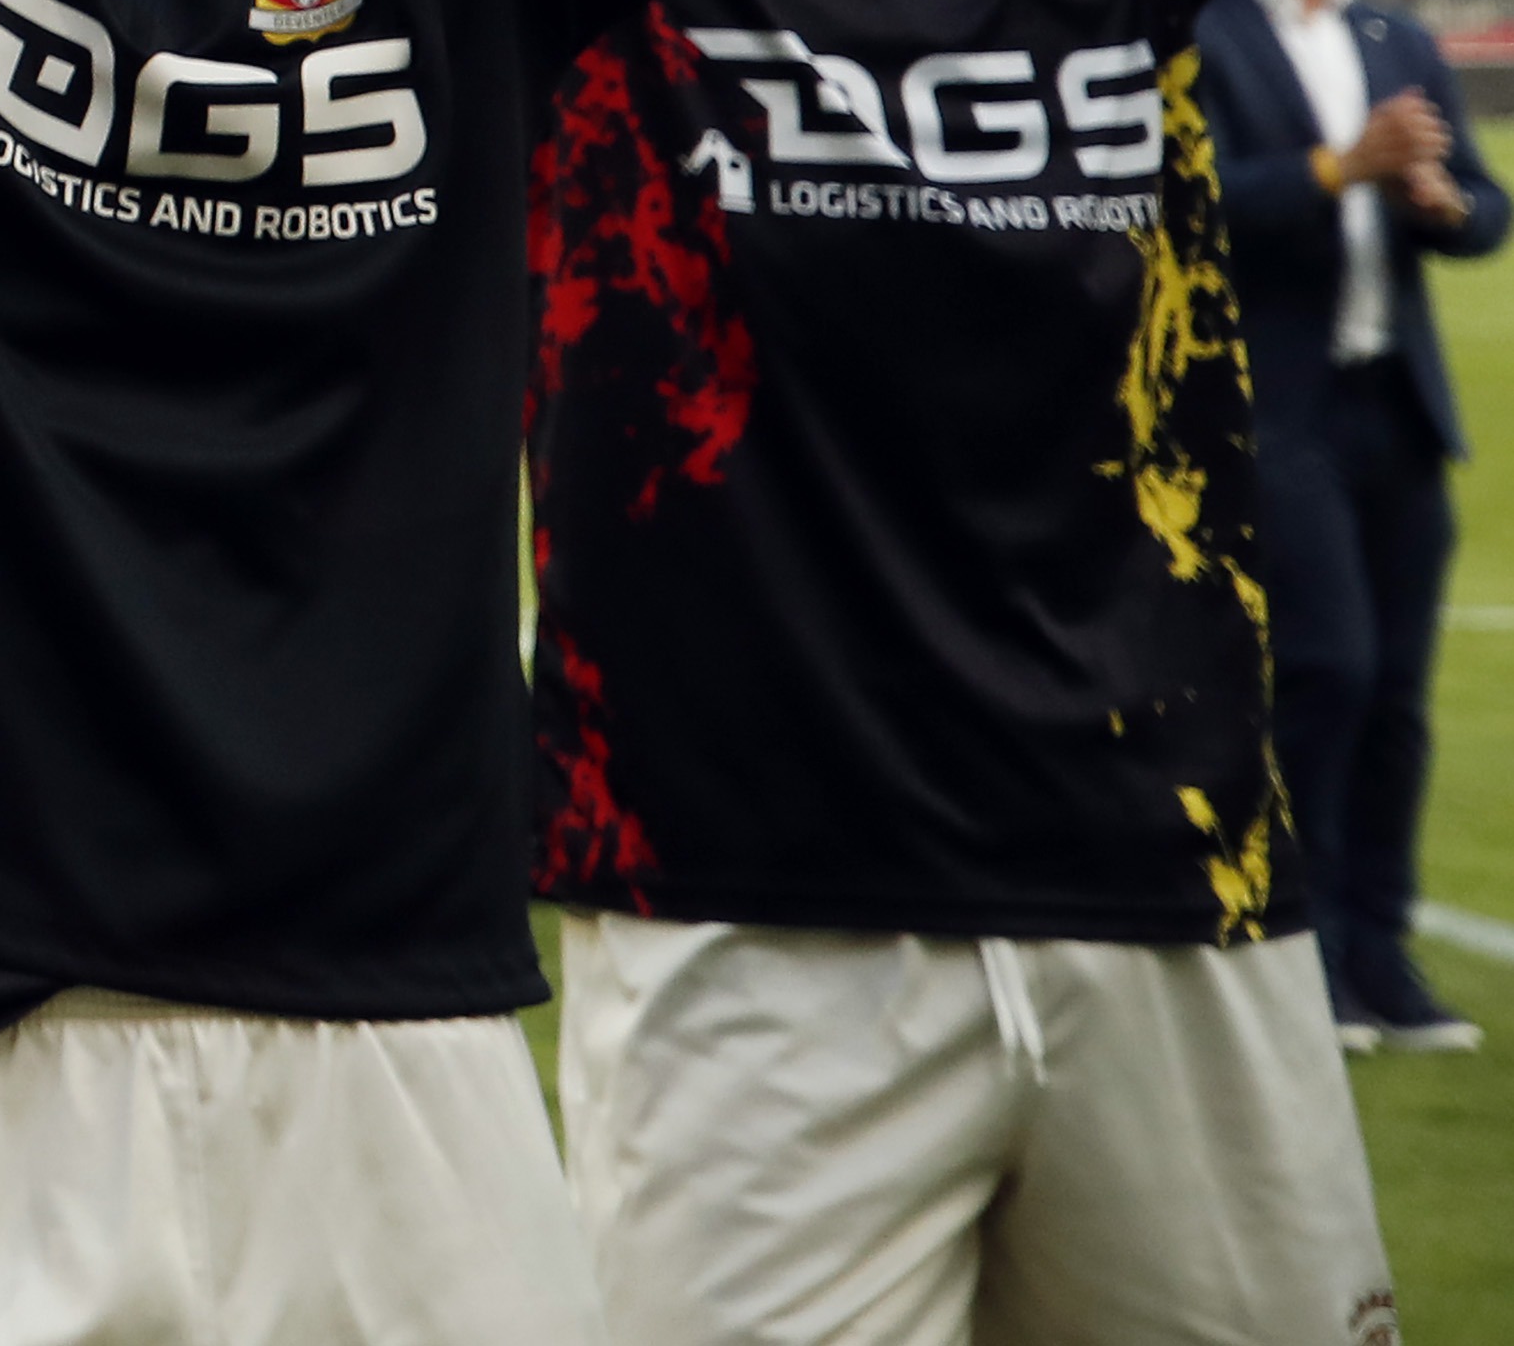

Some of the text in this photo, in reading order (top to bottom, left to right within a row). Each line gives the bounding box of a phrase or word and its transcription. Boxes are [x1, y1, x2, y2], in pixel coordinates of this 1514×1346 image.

[685, 27, 1163, 185] DGS
[150, 193, 241, 238] AND
[255, 187, 438, 241] ROBOTICS
[769, 179, 967, 225] LOGISTICS
[965, 195, 1050, 231] AND
